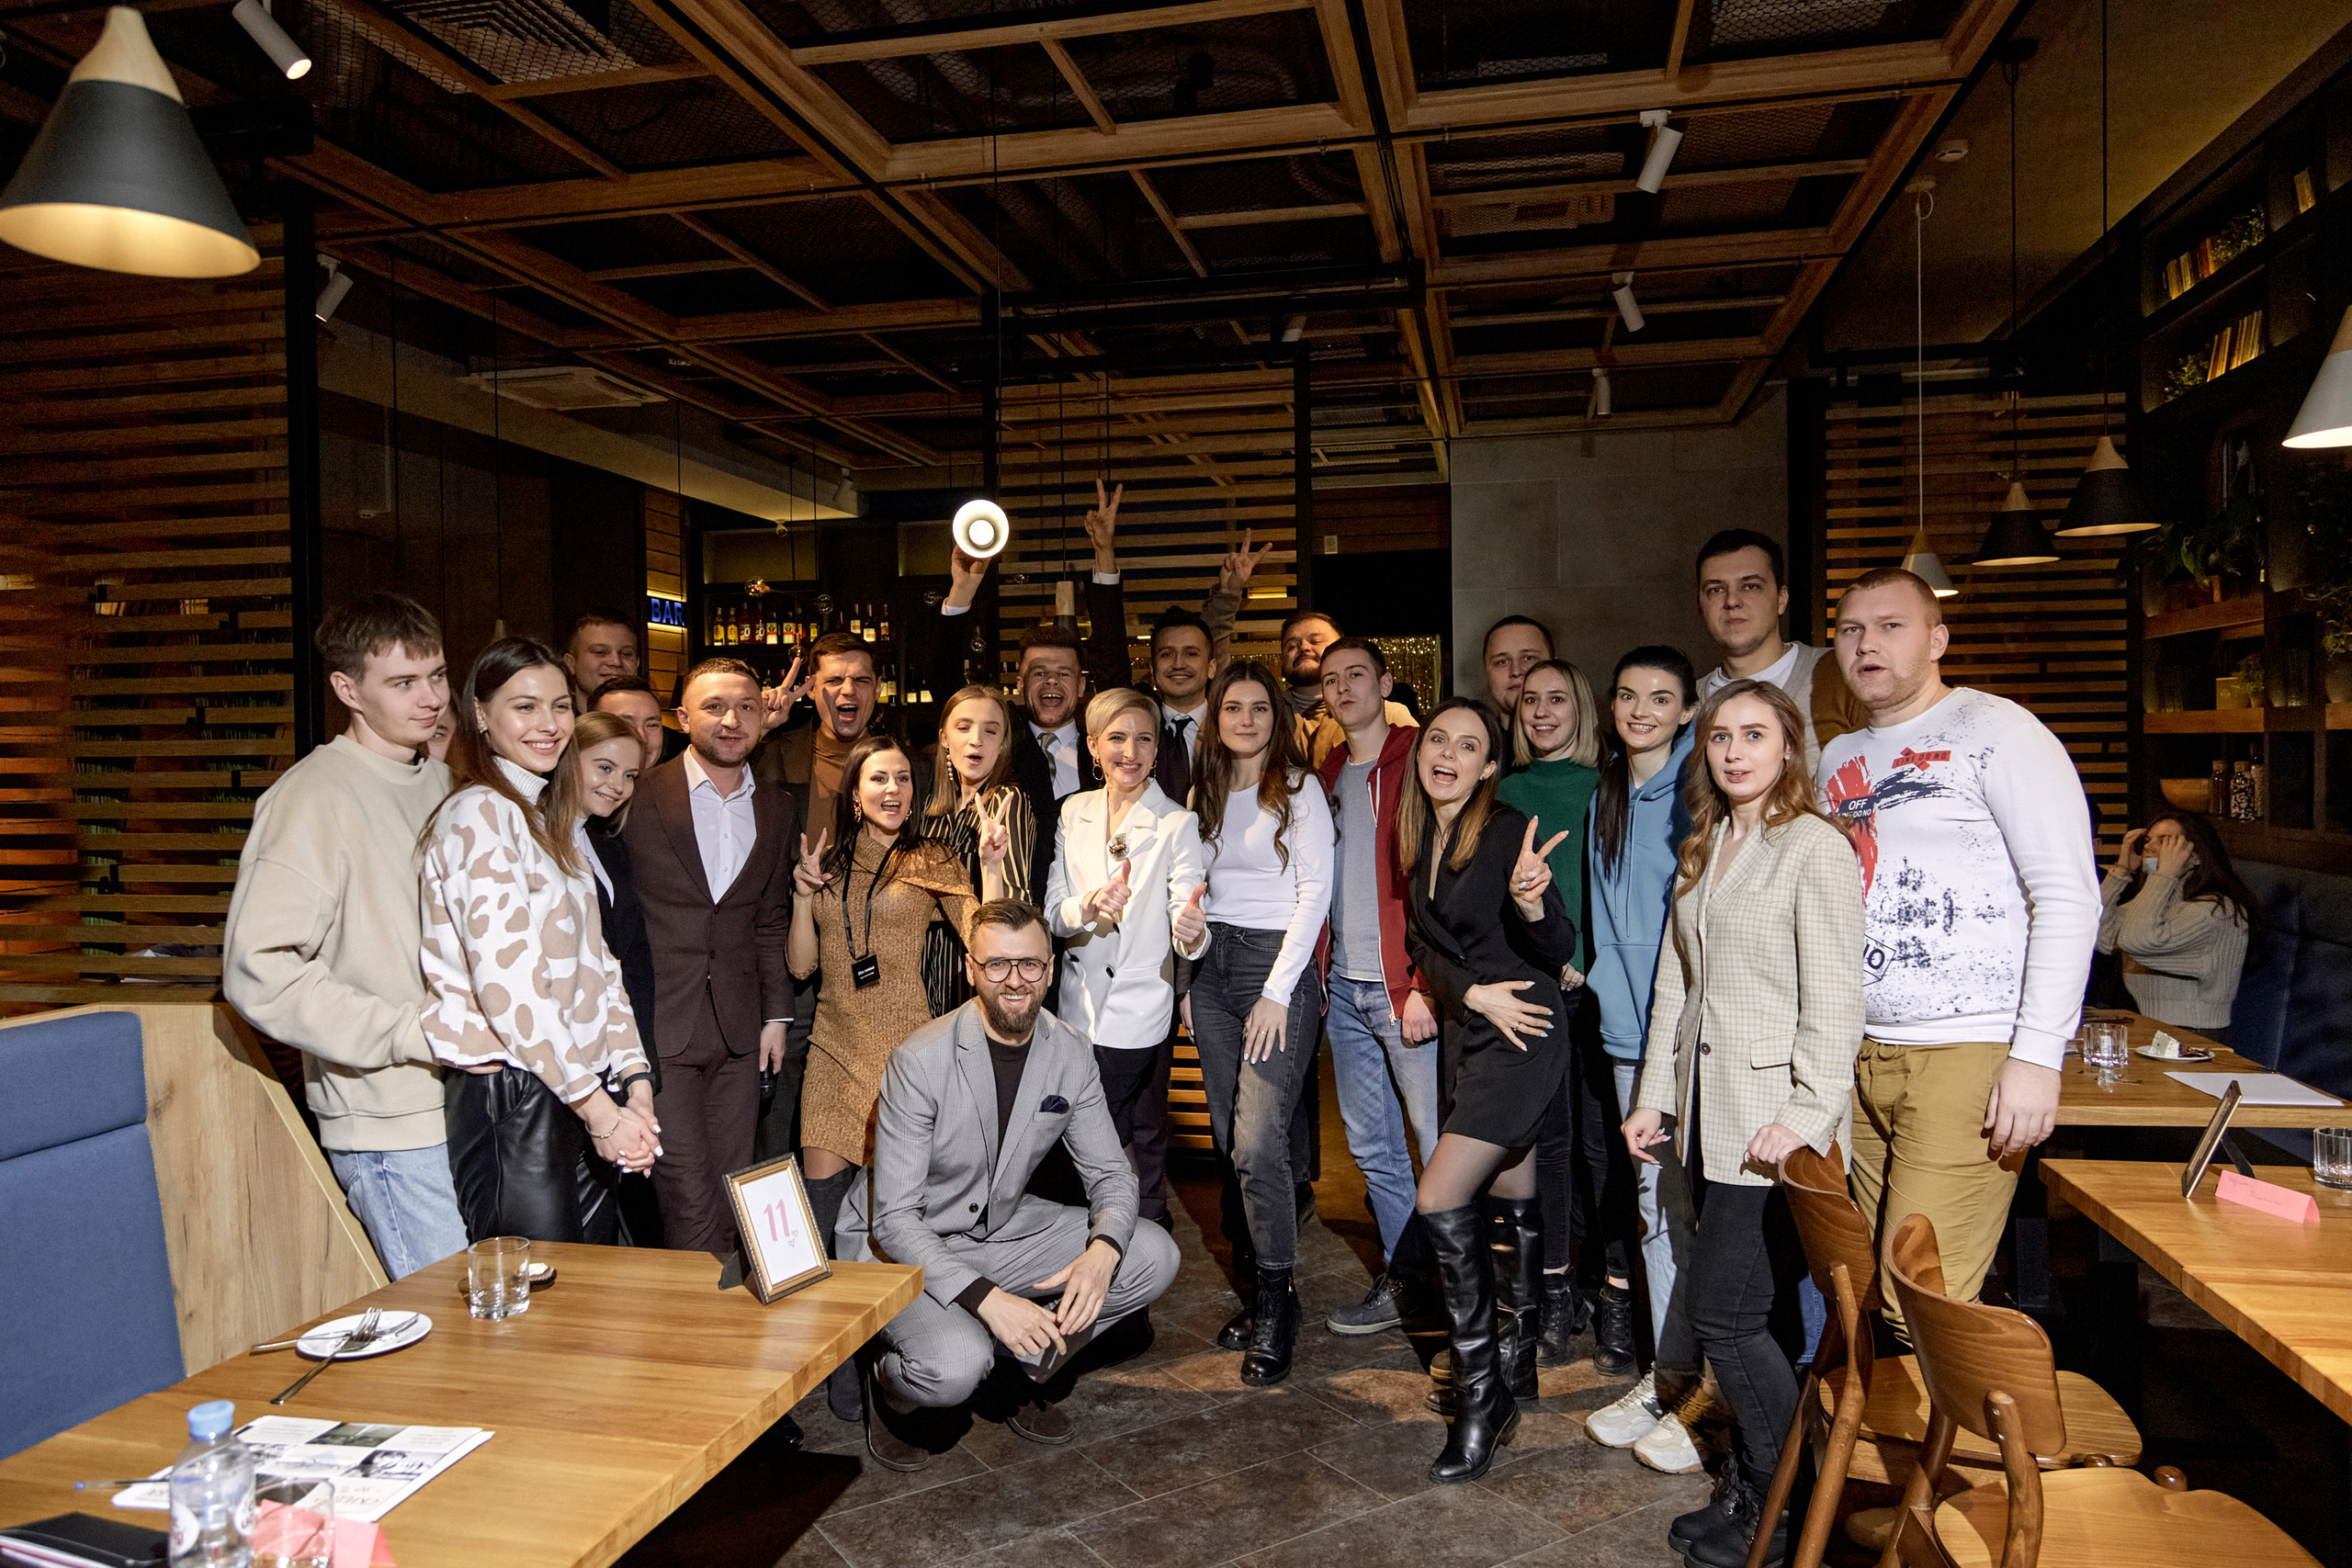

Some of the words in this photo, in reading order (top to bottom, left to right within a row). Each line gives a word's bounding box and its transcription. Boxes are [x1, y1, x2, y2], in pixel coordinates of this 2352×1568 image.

[650, 598, 685, 626] BAR
[1849, 798, 1869, 810] OFF
[1863, 808, 1872, 817] NO
[763, 1199, 790, 1242] 11
